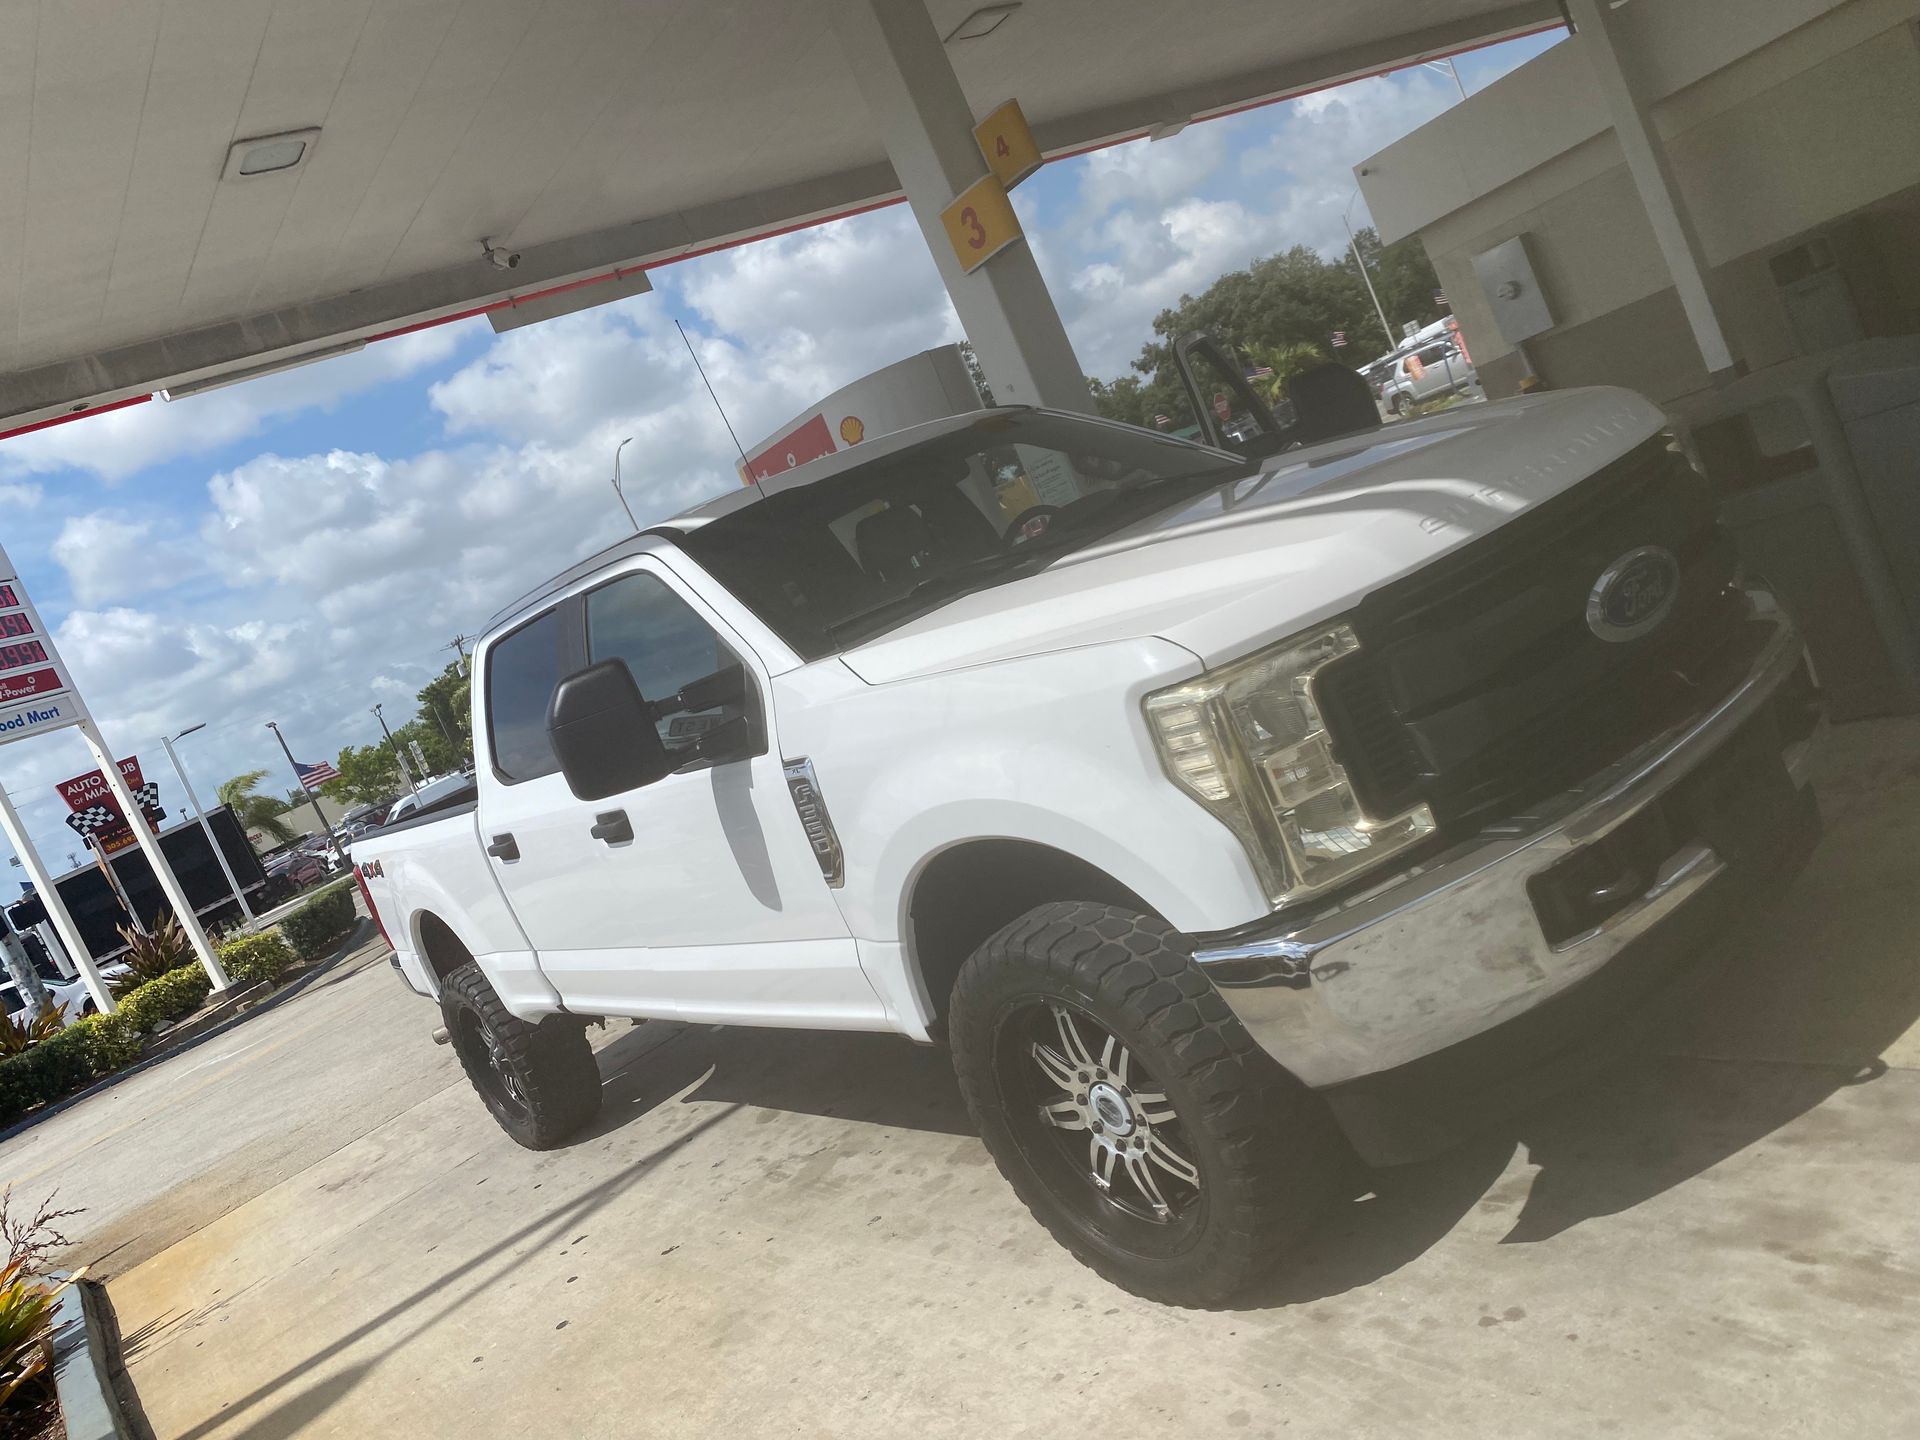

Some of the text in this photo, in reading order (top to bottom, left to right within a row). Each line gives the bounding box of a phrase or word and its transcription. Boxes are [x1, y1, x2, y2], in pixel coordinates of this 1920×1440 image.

[996, 135, 1010, 158] 4
[961, 206, 986, 249] 3
[0, 706, 60, 731] ood Mart
[67, 762, 136, 796] AUTO UB
